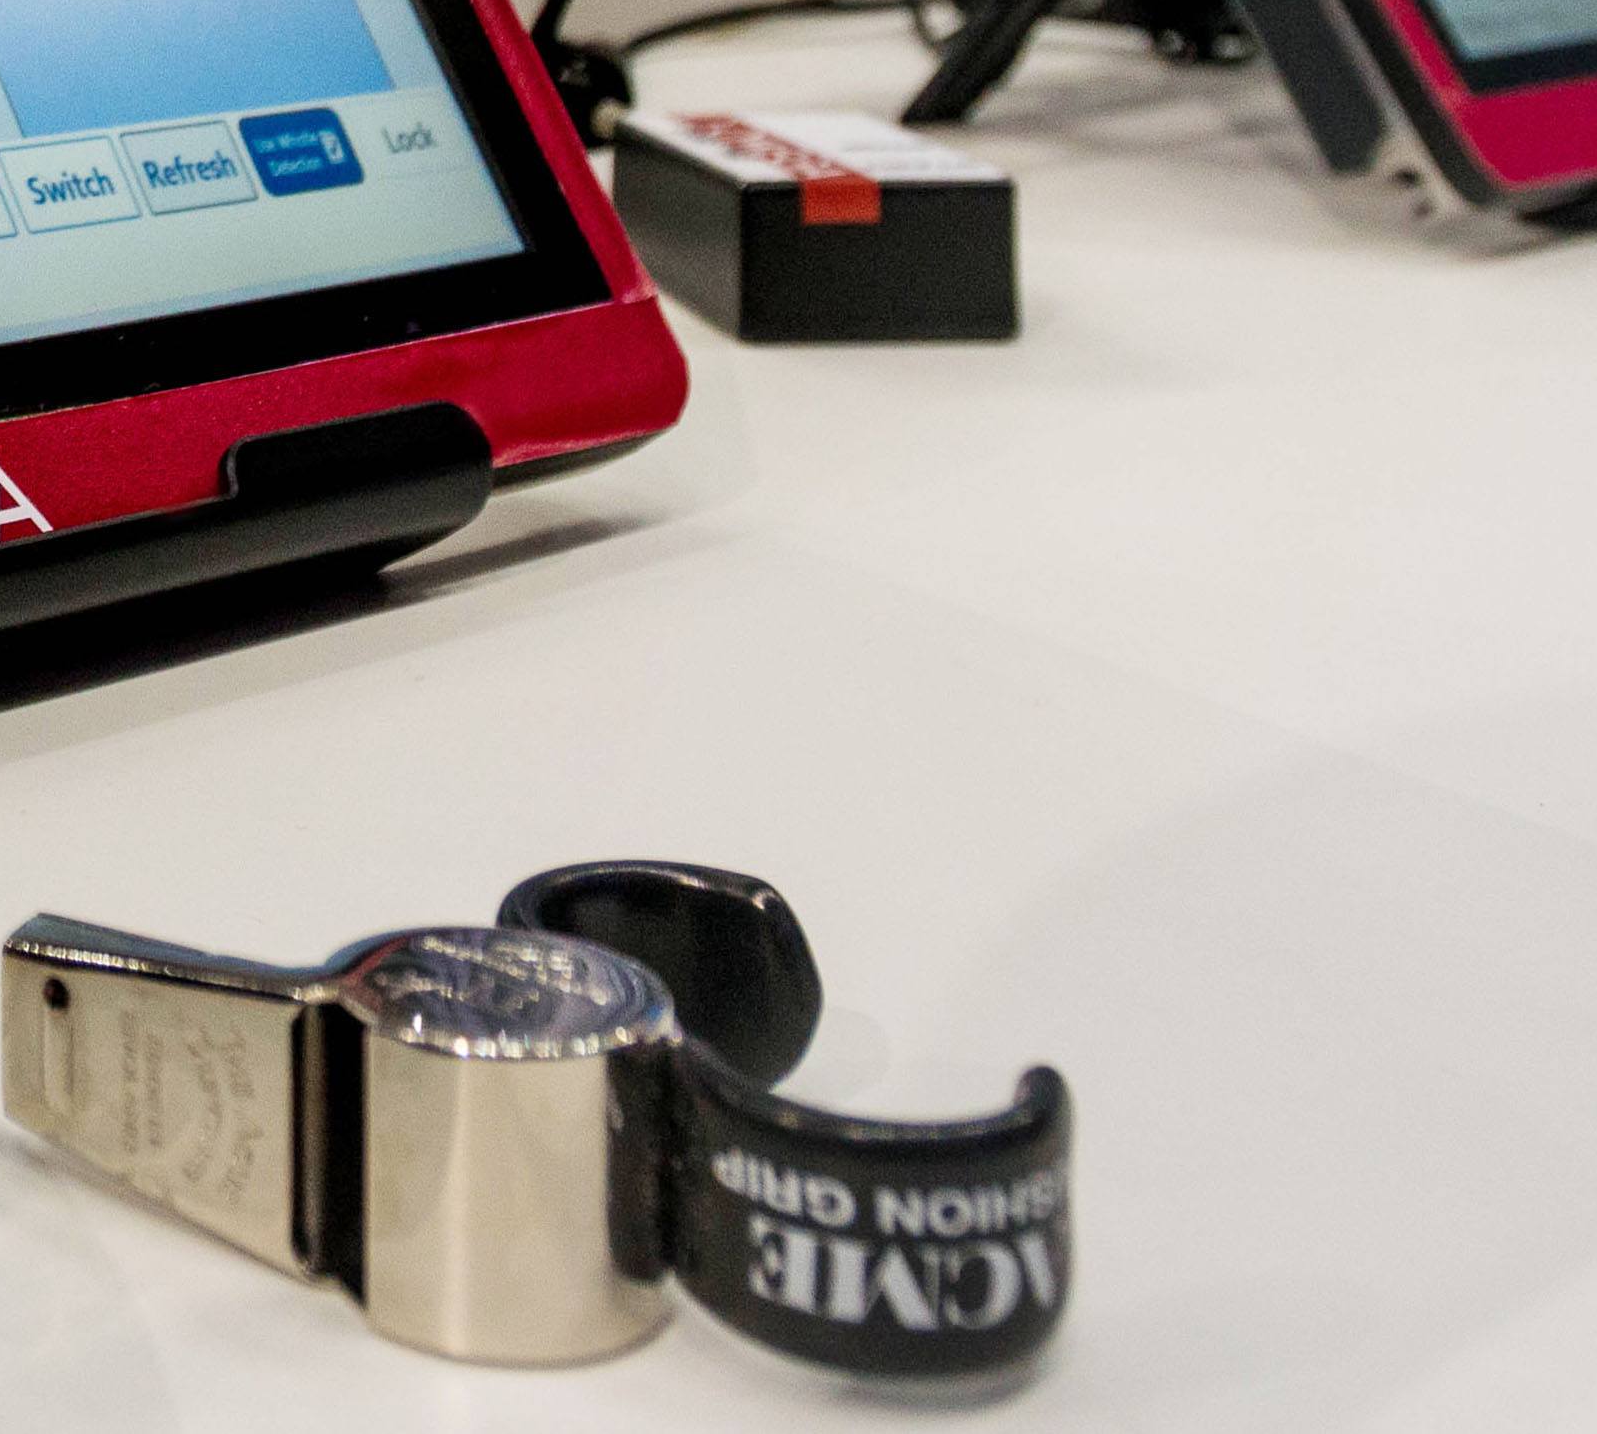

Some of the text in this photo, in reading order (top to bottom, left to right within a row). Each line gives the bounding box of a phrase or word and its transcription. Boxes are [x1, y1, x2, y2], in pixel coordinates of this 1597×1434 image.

[382, 121, 439, 155] Lock
[27, 168, 116, 206] Switch
[142, 151, 238, 190] Refresh
[710, 1144, 858, 1228] GRIP
